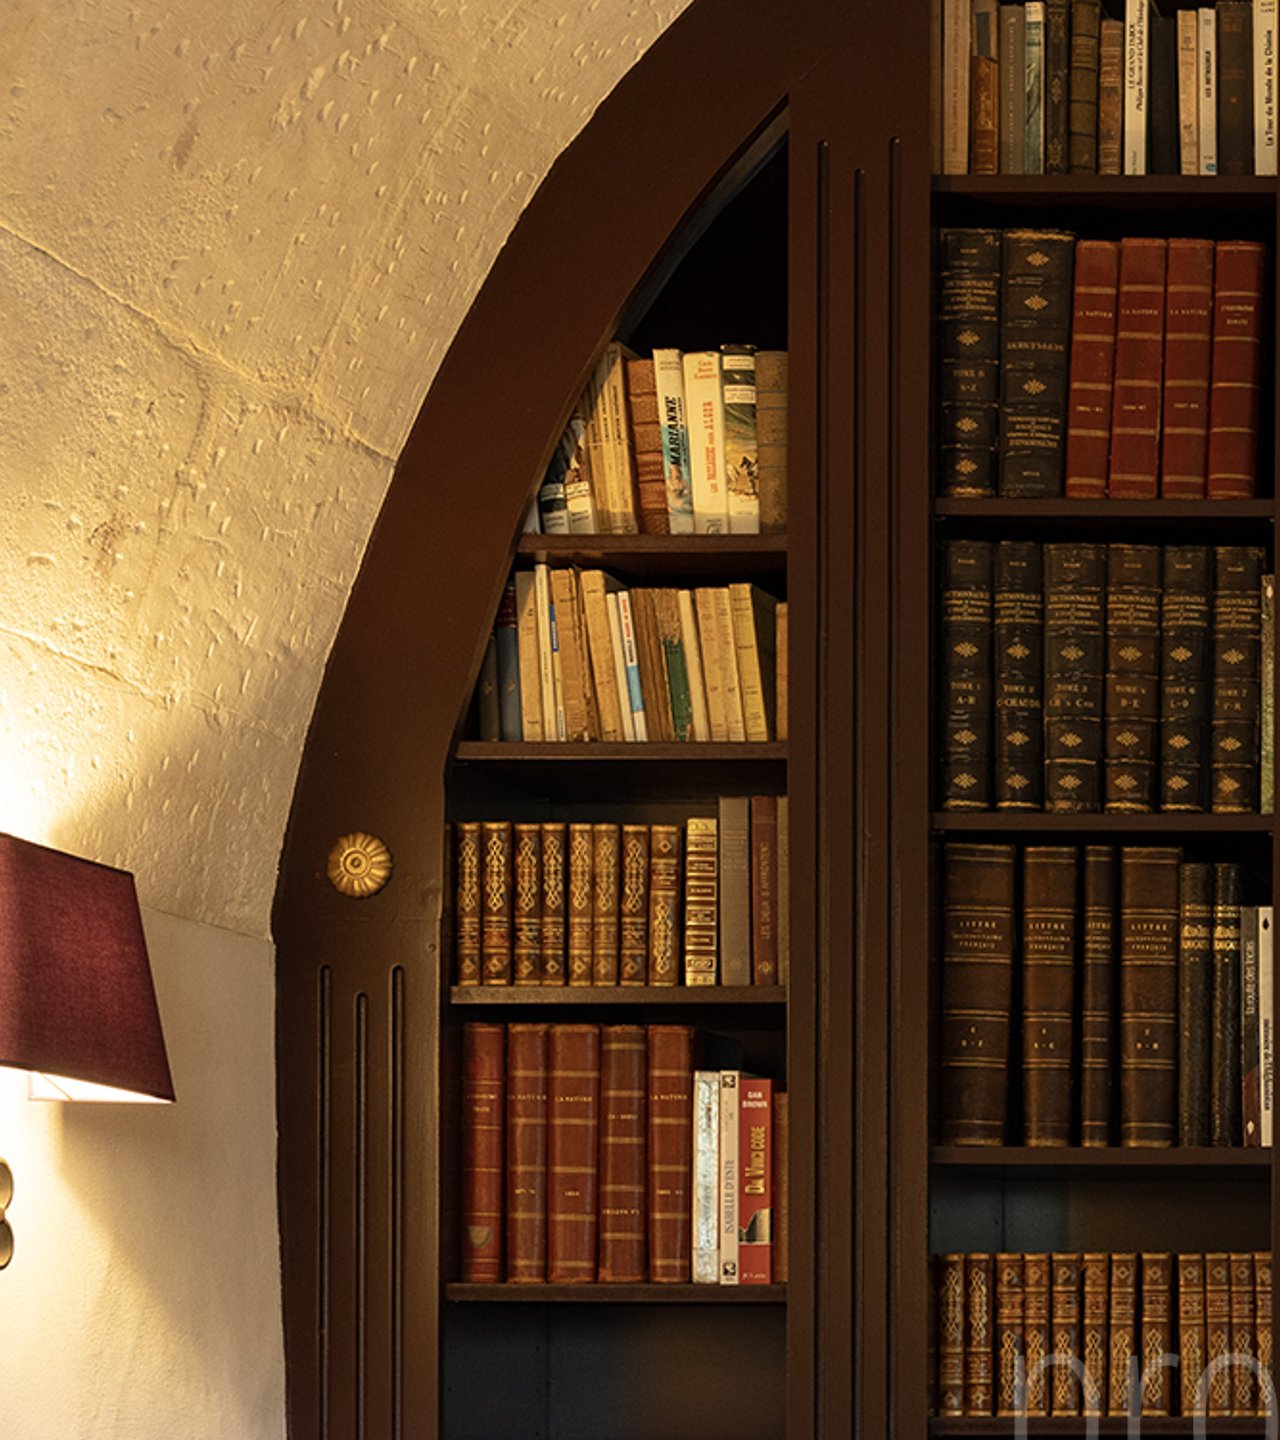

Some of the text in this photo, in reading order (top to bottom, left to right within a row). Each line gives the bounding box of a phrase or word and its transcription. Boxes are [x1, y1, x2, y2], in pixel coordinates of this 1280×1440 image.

[1264, 30, 1273, 56] Chimie
[1128, 48, 1136, 78] GRAND
[1265, 78, 1273, 104] Monde
[1265, 117, 1274, 135] Tour
[665, 396, 681, 467] MARIANNE
[742, 1100, 768, 1108] BROWN
